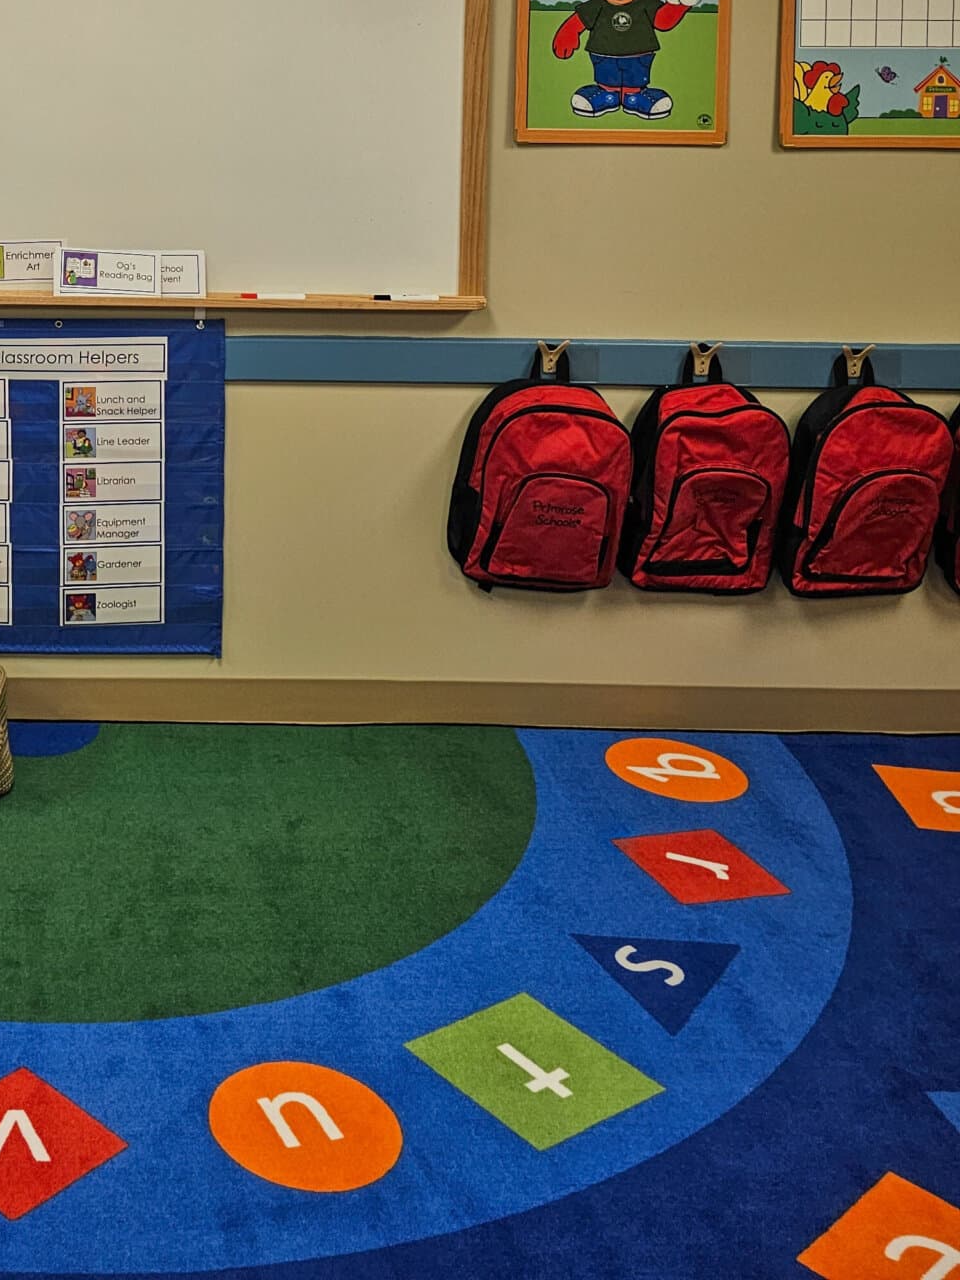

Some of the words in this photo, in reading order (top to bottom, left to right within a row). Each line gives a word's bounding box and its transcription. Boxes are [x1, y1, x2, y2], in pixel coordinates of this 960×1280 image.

[25, 261, 41, 271] Art
[116, 261, 136, 271] Og's
[160, 265, 184, 273] chool
[99, 271, 134, 281] Reading
[136, 273, 153, 282] Bag
[160, 275, 181, 283] vent
[79, 350, 140, 367] Helpers
[96, 395, 125, 404] Lunch
[126, 395, 146, 404] and
[96, 407, 125, 416] Snack
[126, 406, 157, 417] Helper
[96, 436, 114, 445] Line
[117, 436, 150, 445] Leader
[96, 477, 136, 485] Librarian
[96, 518, 146, 528] Equipment
[96, 529, 139, 540] Manager
[97, 560, 142, 569] Gardener
[96, 600, 137, 610] Zoologist
